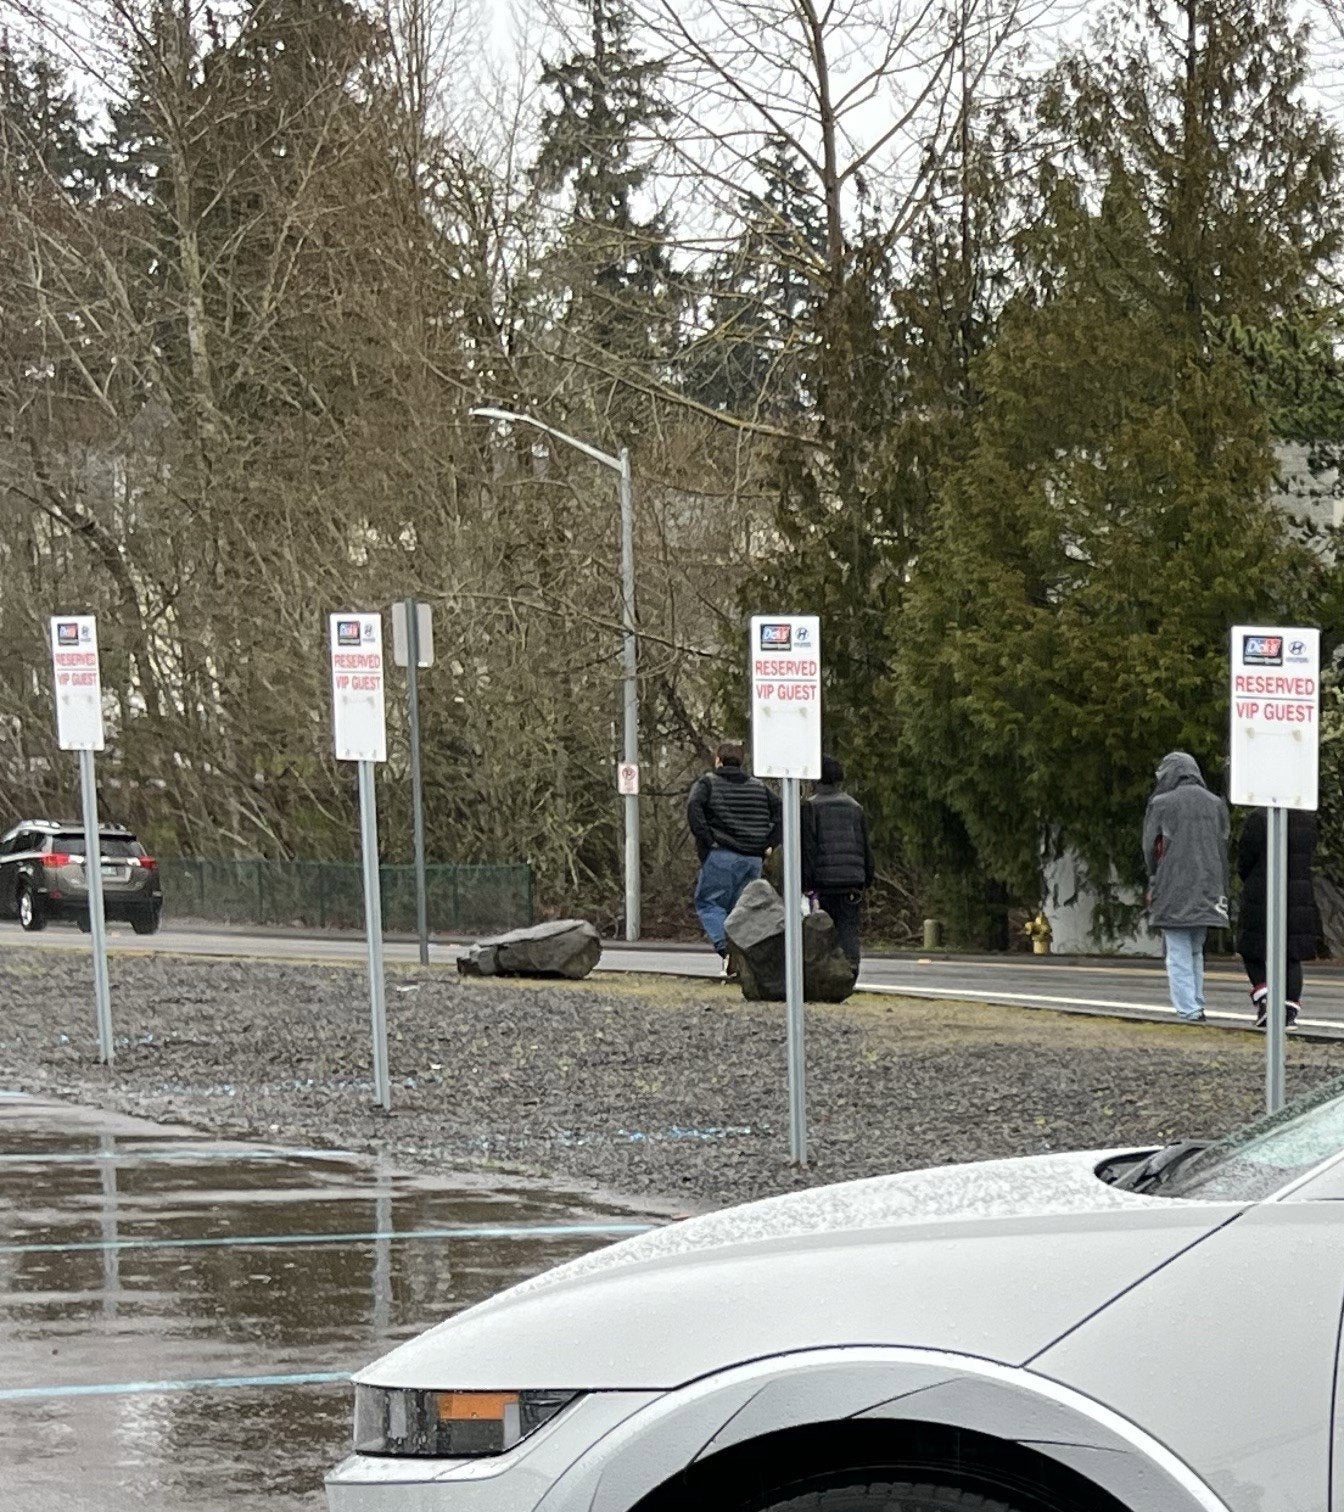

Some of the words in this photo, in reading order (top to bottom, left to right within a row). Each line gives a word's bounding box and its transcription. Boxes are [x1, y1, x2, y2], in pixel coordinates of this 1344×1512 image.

[755, 660, 817, 676] RESERVED
[352, 676, 380, 690] GUEST
[1235, 675, 1315, 695] RESERVED
[756, 684, 774, 699] VIP
[777, 684, 817, 700] GUEST
[1236, 702, 1259, 719] VIP
[1263, 703, 1314, 722] GUEST
